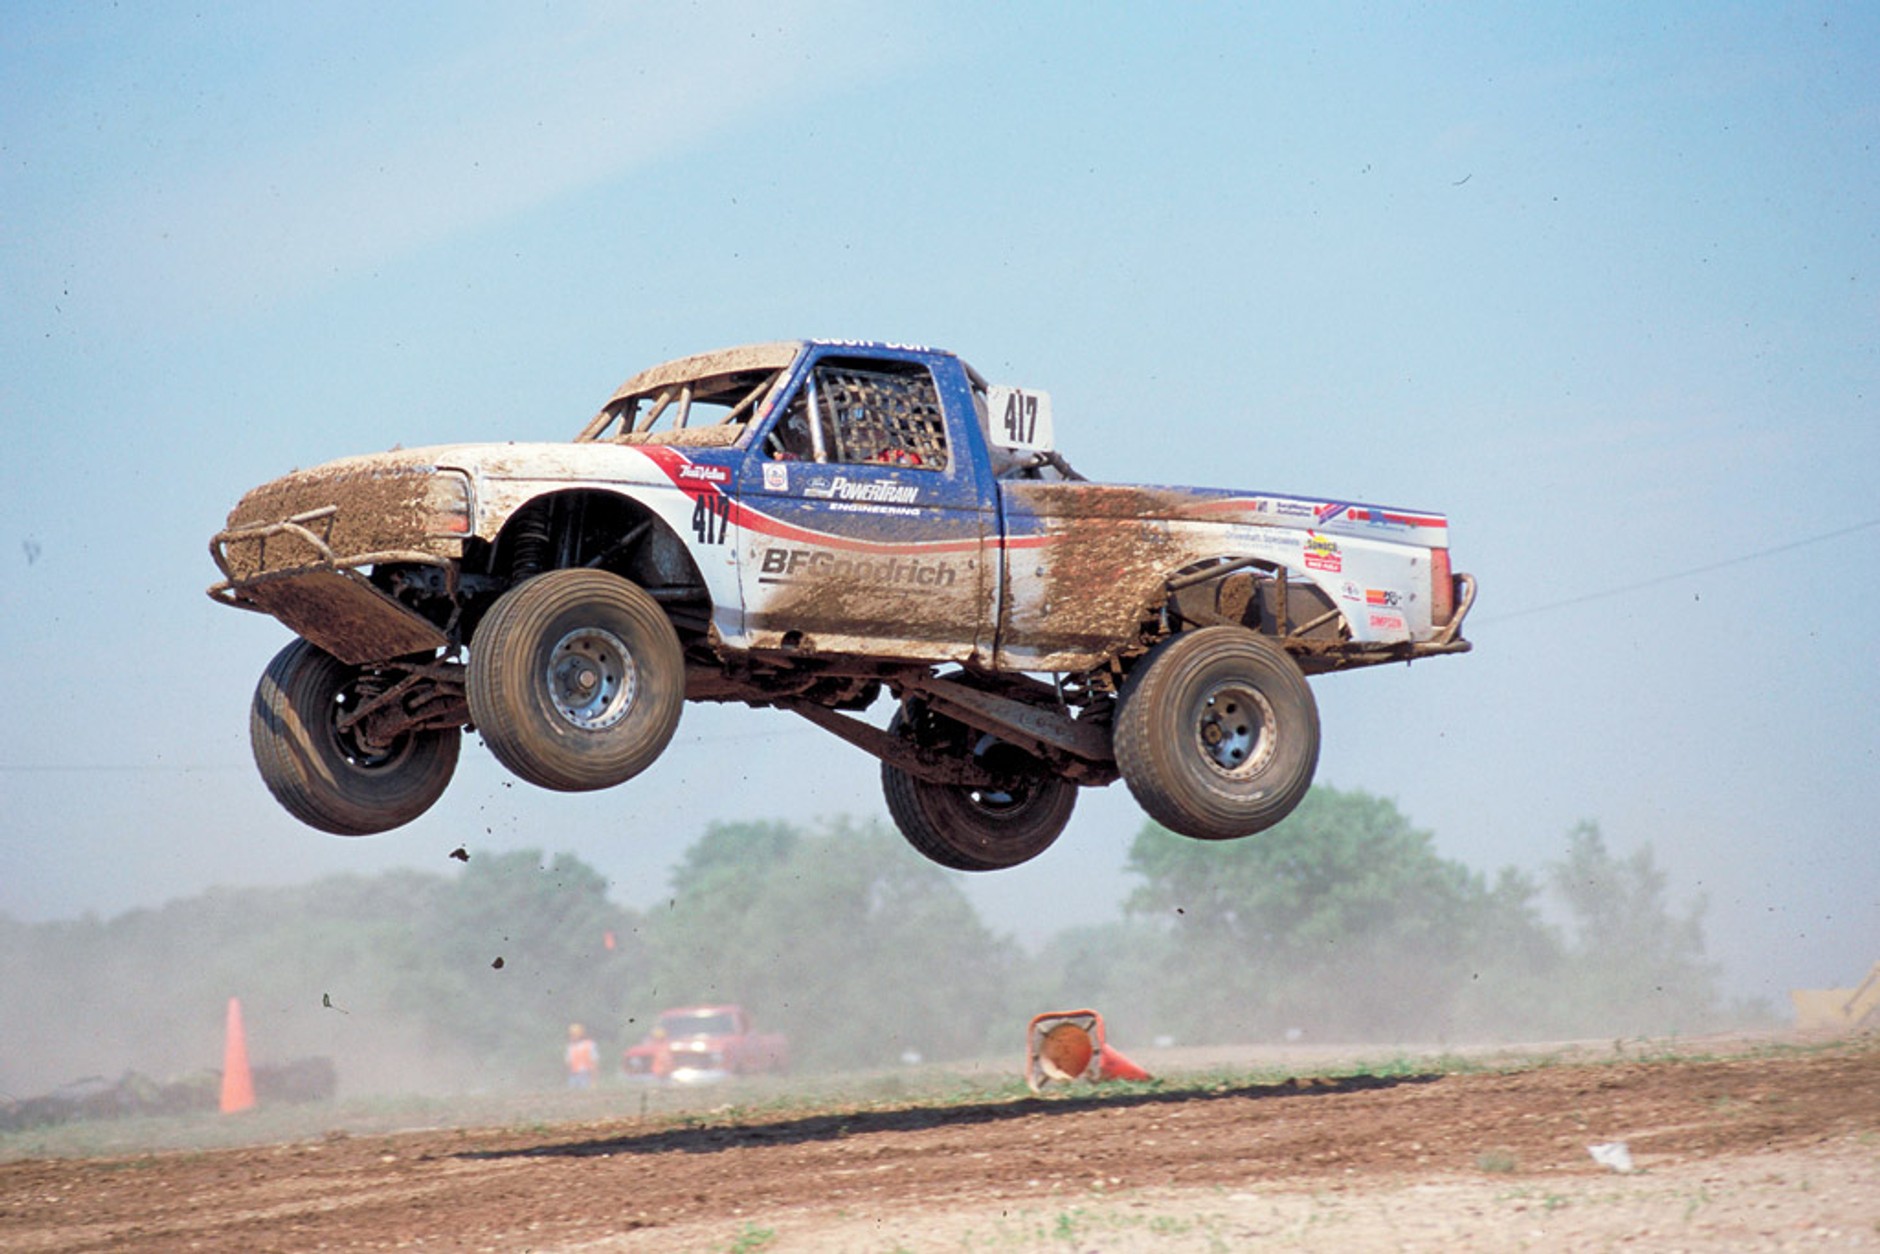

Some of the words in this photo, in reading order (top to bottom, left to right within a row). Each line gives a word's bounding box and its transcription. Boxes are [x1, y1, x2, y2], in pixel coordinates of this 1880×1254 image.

[1004, 393, 1038, 444] 417
[692, 494, 729, 545] 417
[829, 503, 920, 516] ENGINEERING
[761, 548, 956, 586] BFGoodrich
